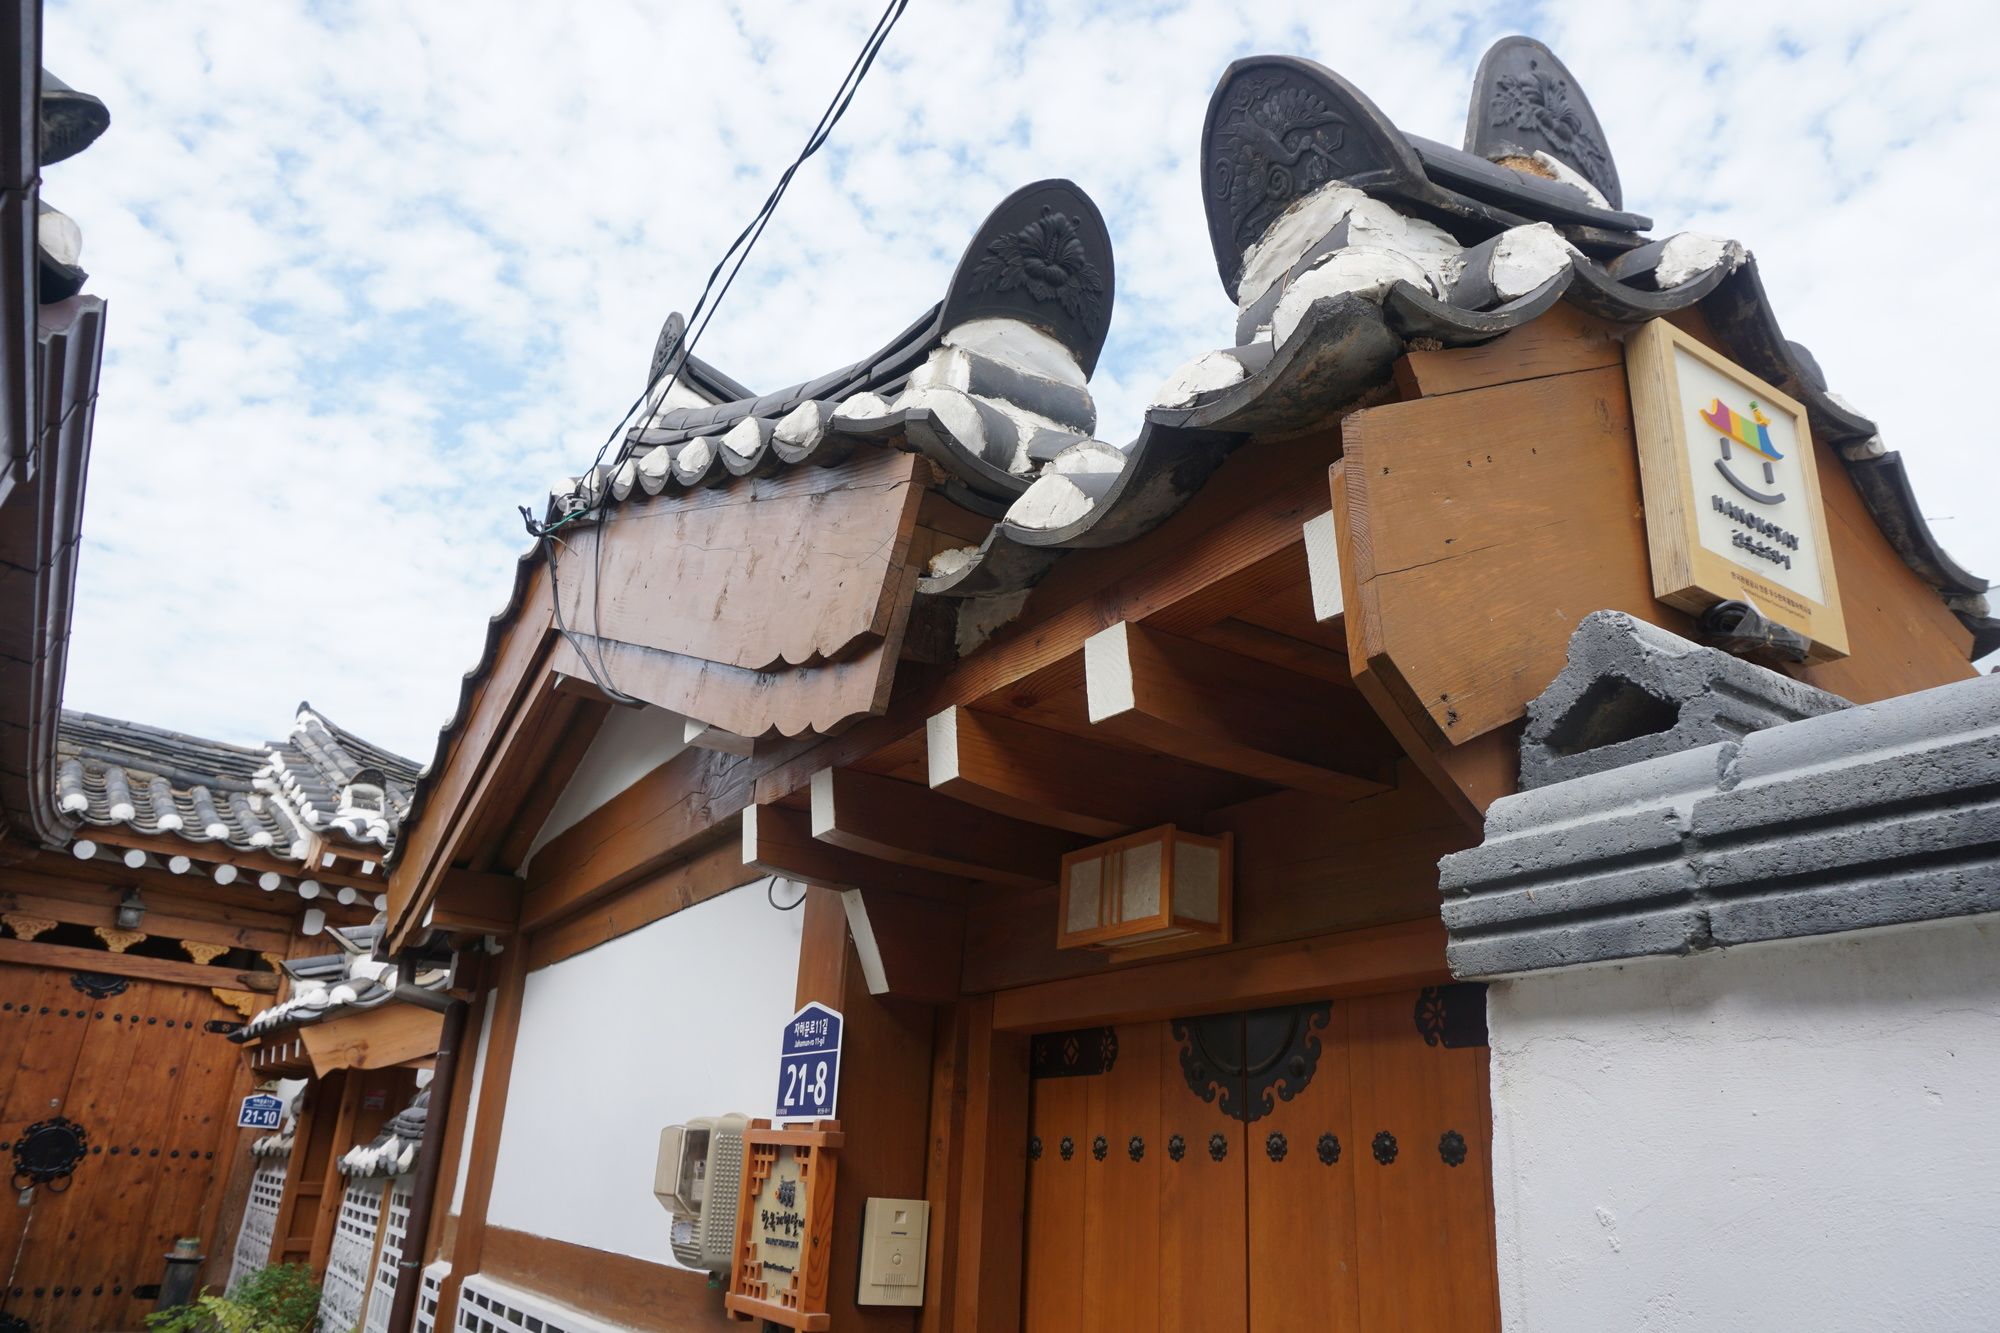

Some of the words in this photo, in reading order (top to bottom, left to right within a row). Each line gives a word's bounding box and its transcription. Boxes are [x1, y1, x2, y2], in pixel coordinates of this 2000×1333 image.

[1712, 495, 1799, 551] HANOKSTAY
[1731, 529, 1791, 570] 한옥스테이
[794, 1018, 828, 1037] 자하문로11길
[784, 1061, 828, 1106] 21-8
[243, 1110, 277, 1124] 21-10
